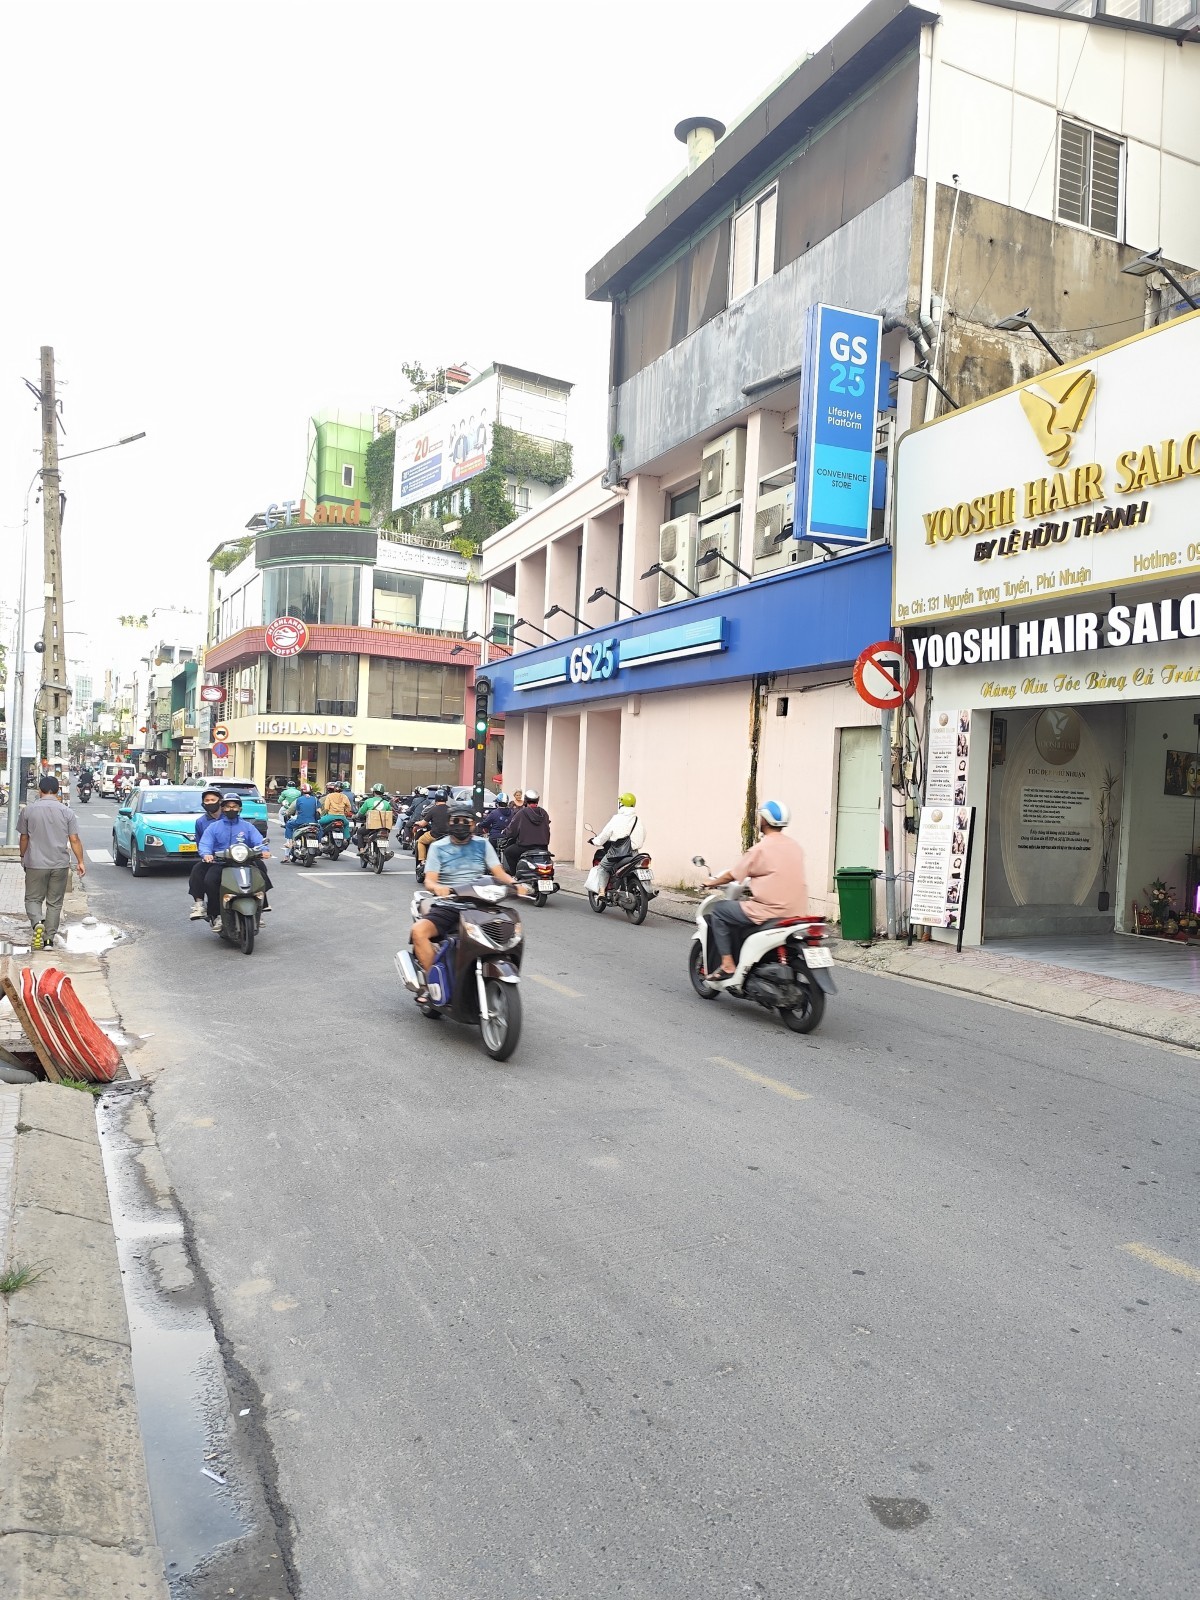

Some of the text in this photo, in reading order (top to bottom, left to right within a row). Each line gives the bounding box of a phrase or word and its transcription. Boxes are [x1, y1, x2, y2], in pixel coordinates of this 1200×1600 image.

[830, 331, 868, 365] GS
[829, 363, 866, 397] 25
[827, 416, 862, 430] Platform
[828, 406, 862, 420] Lifestyle
[414, 436, 429, 462] 20
[817, 468, 867, 482] CONVENIENCE
[832, 480, 852, 490] STORE
[922, 487, 1016, 545] YOOSHI
[1023, 462, 1104, 519] HAIR
[974, 501, 1149, 562] BY LÊ HỮU THÀNH
[1133, 549, 1182, 572] Hotline:
[898, 604, 910, 620] Địa
[912, 598, 926, 614] Chỉ:
[928, 596, 940, 612] 131
[944, 587, 974, 611] Nguyễn
[976, 586, 1000, 604] Trọng
[1036, 571, 1056, 591] Phú
[1060, 566, 1092, 586] Nhuận
[268, 618, 305, 636] HIGHLANDS
[272, 645, 300, 656] COFFEE
[912, 624, 1011, 670] YOOSHI
[1018, 612, 1098, 658] HAIR
[570, 638, 618, 684] GS25
[1020, 677, 1049, 694] Niu
[1054, 673, 1080, 692] Tóc
[1085, 670, 1128, 692] Bằng
[1132, 667, 1154, 686] Cả
[256, 721, 354, 736] HIGHLANDS
